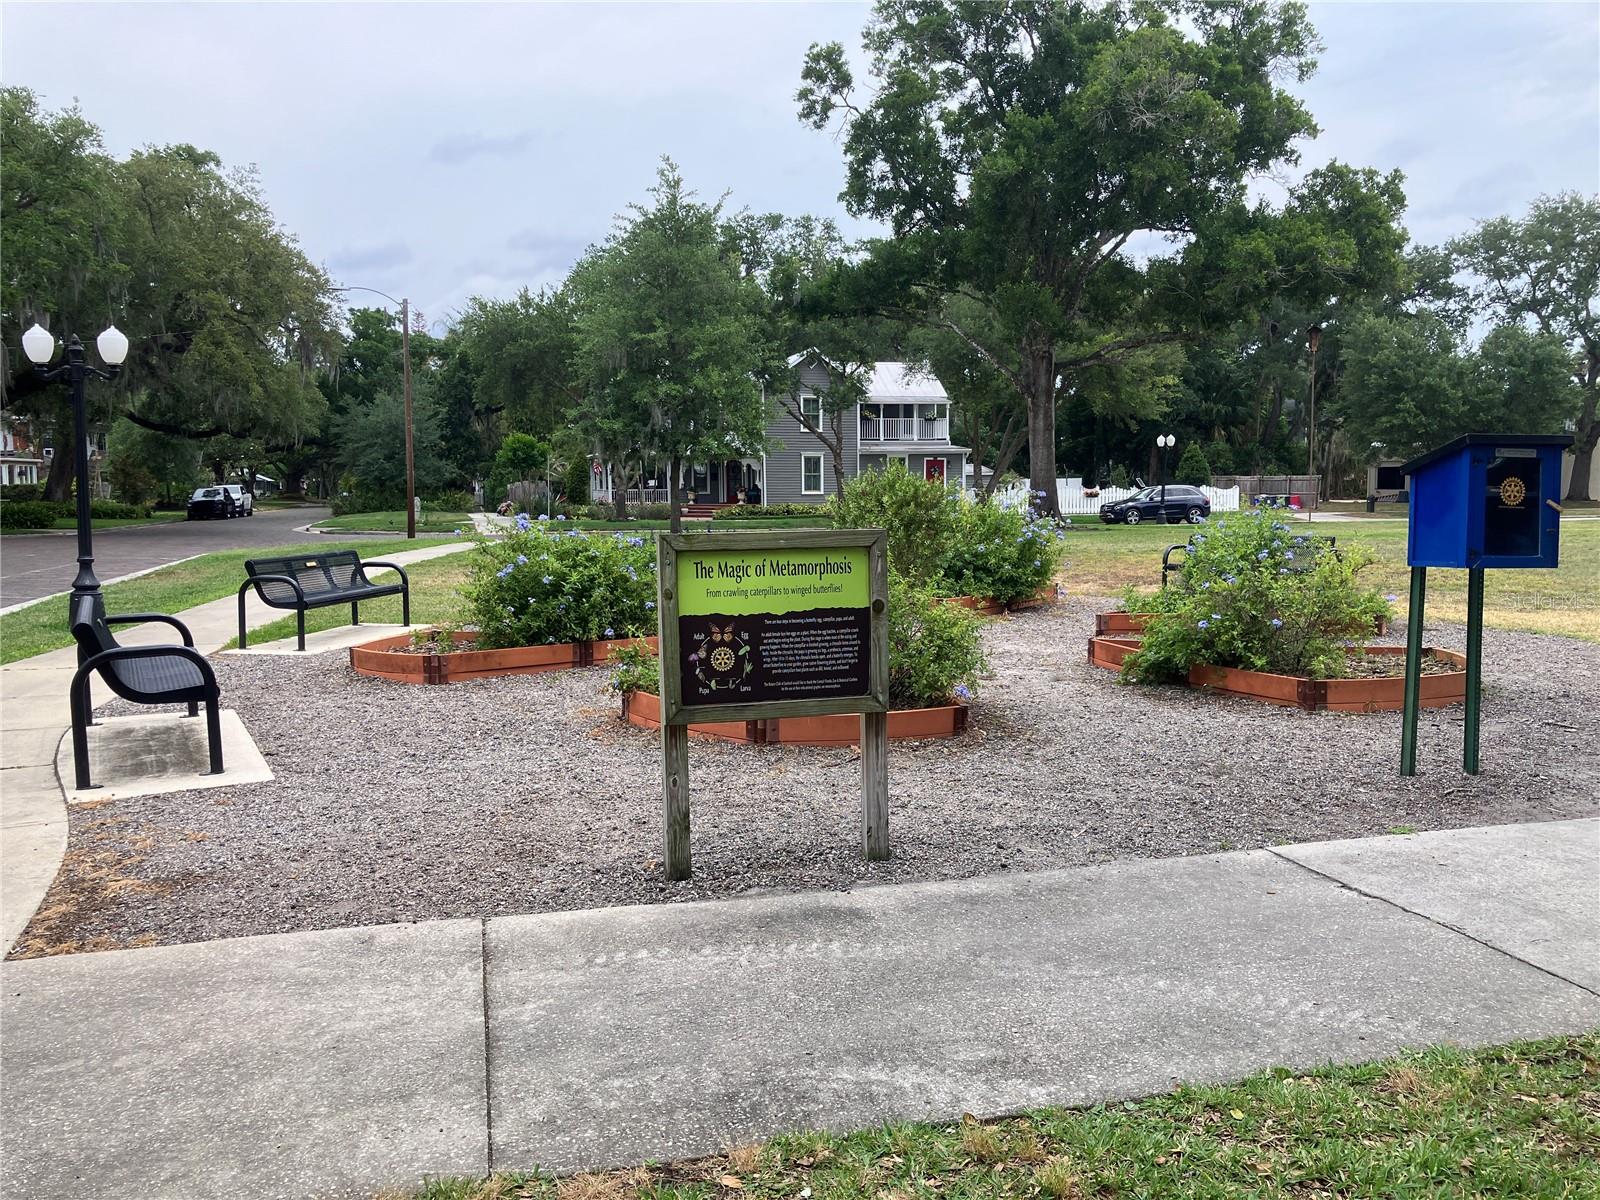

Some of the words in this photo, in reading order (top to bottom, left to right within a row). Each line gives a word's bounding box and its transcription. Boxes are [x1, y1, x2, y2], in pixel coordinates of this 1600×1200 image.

[693, 560, 714, 579] The
[717, 559, 752, 584] Magic
[755, 558, 767, 577] of
[769, 556, 852, 581] Metamorphosis
[706, 588, 722, 598] From
[722, 587, 749, 600] crawling
[749, 586, 782, 598] caterpillars
[783, 586, 790, 595] to
[790, 584, 812, 597] winged
[812, 583, 843, 594] butterflies!
[693, 632, 705, 641] Adult
[741, 631, 749, 641] Egg
[698, 687, 710, 696] Pupa
